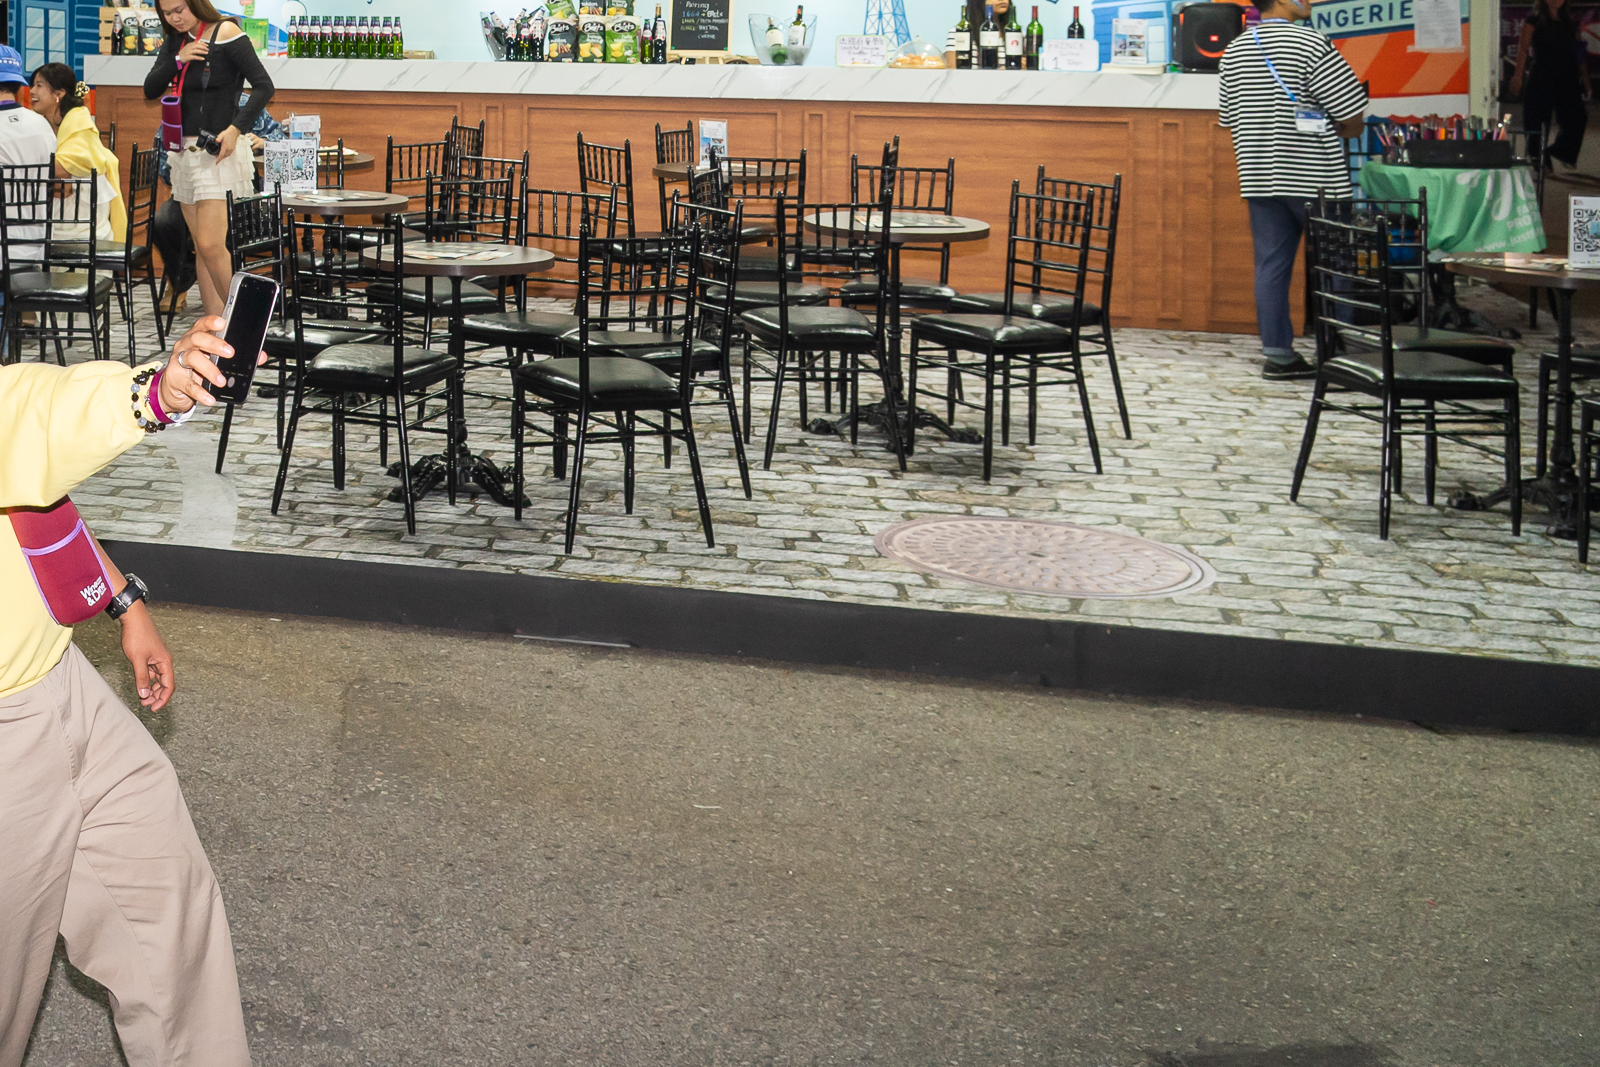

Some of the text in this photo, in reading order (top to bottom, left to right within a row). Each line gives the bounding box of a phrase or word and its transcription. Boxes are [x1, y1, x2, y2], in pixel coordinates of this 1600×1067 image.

[685, 0, 710, 12] Pairing
[682, 10, 700, 18] 1664
[1052, 56, 1062, 69] 1
[79, 581, 99, 600] Wine
[91, 582, 106, 602] Dine
[86, 596, 97, 607] &
